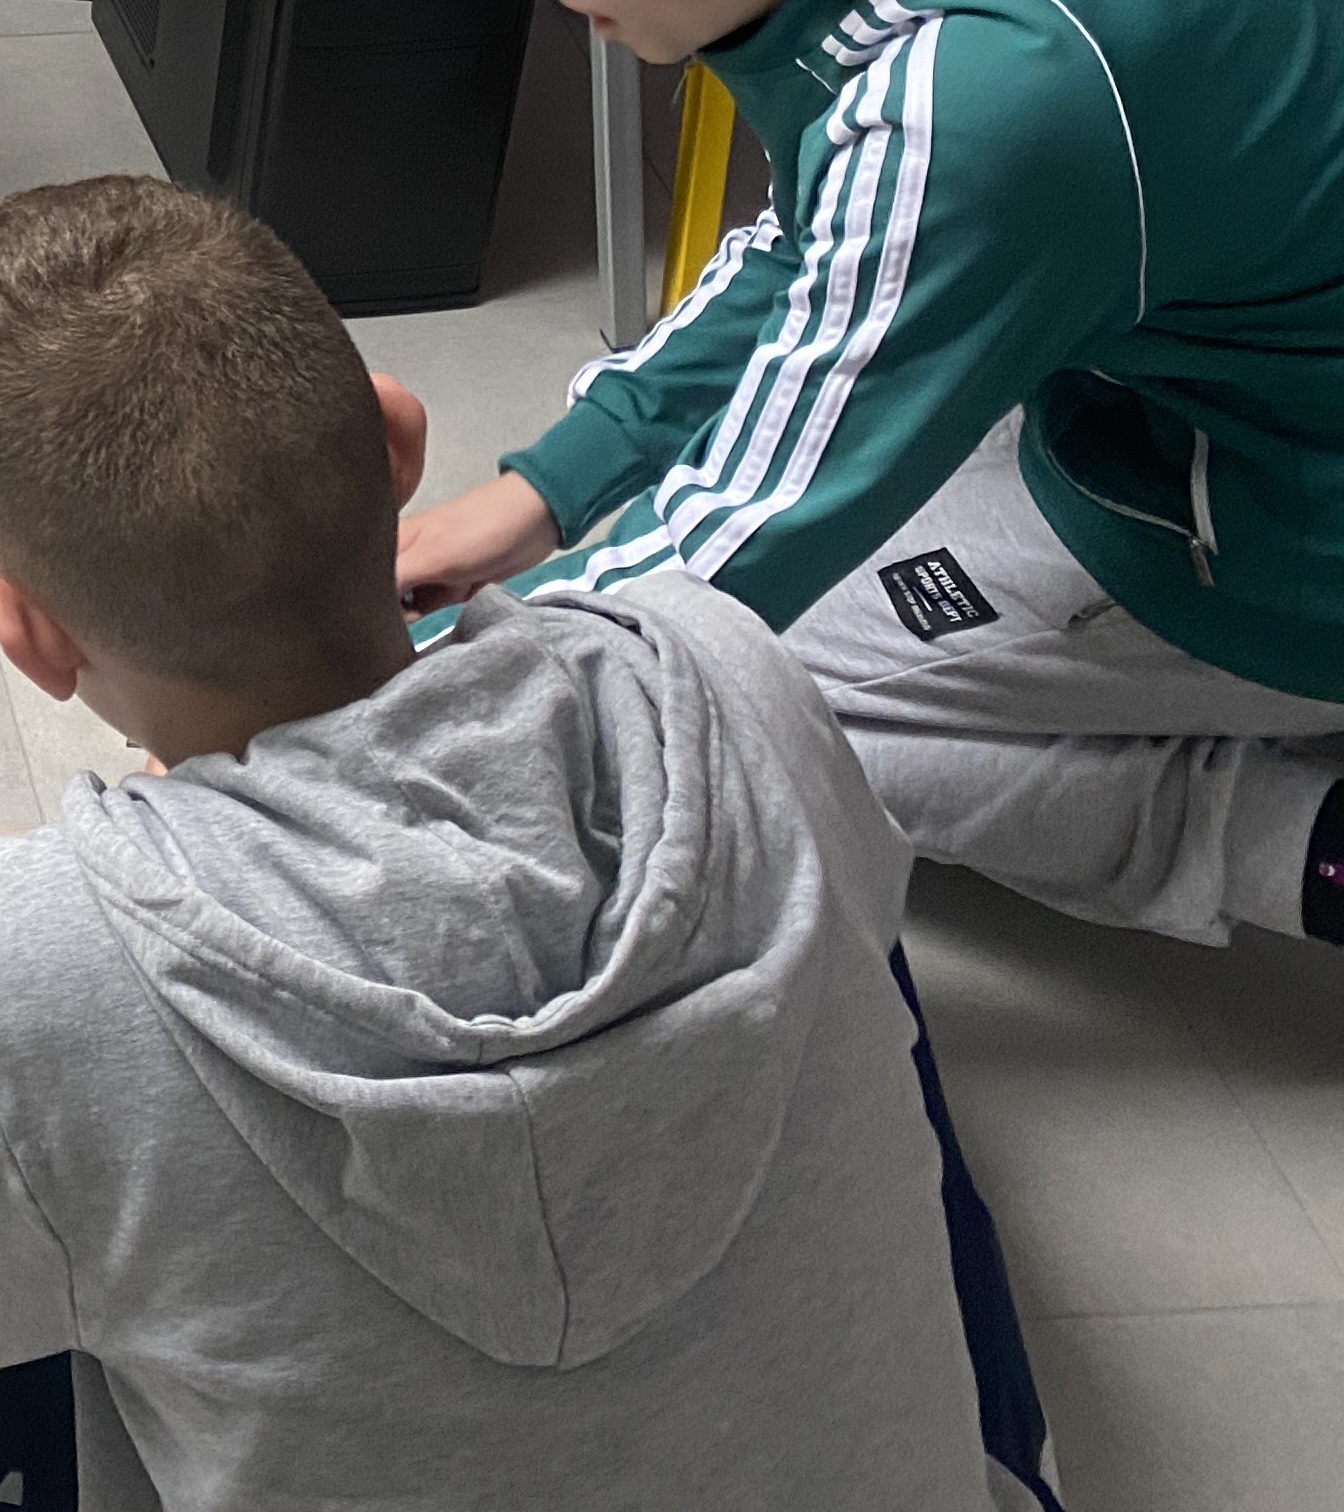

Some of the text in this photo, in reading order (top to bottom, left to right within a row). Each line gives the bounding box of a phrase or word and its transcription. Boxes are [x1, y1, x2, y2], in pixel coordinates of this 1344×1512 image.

[915, 565, 962, 623] SPORTS DEPT
[928, 561, 979, 618] ATHLETIC
